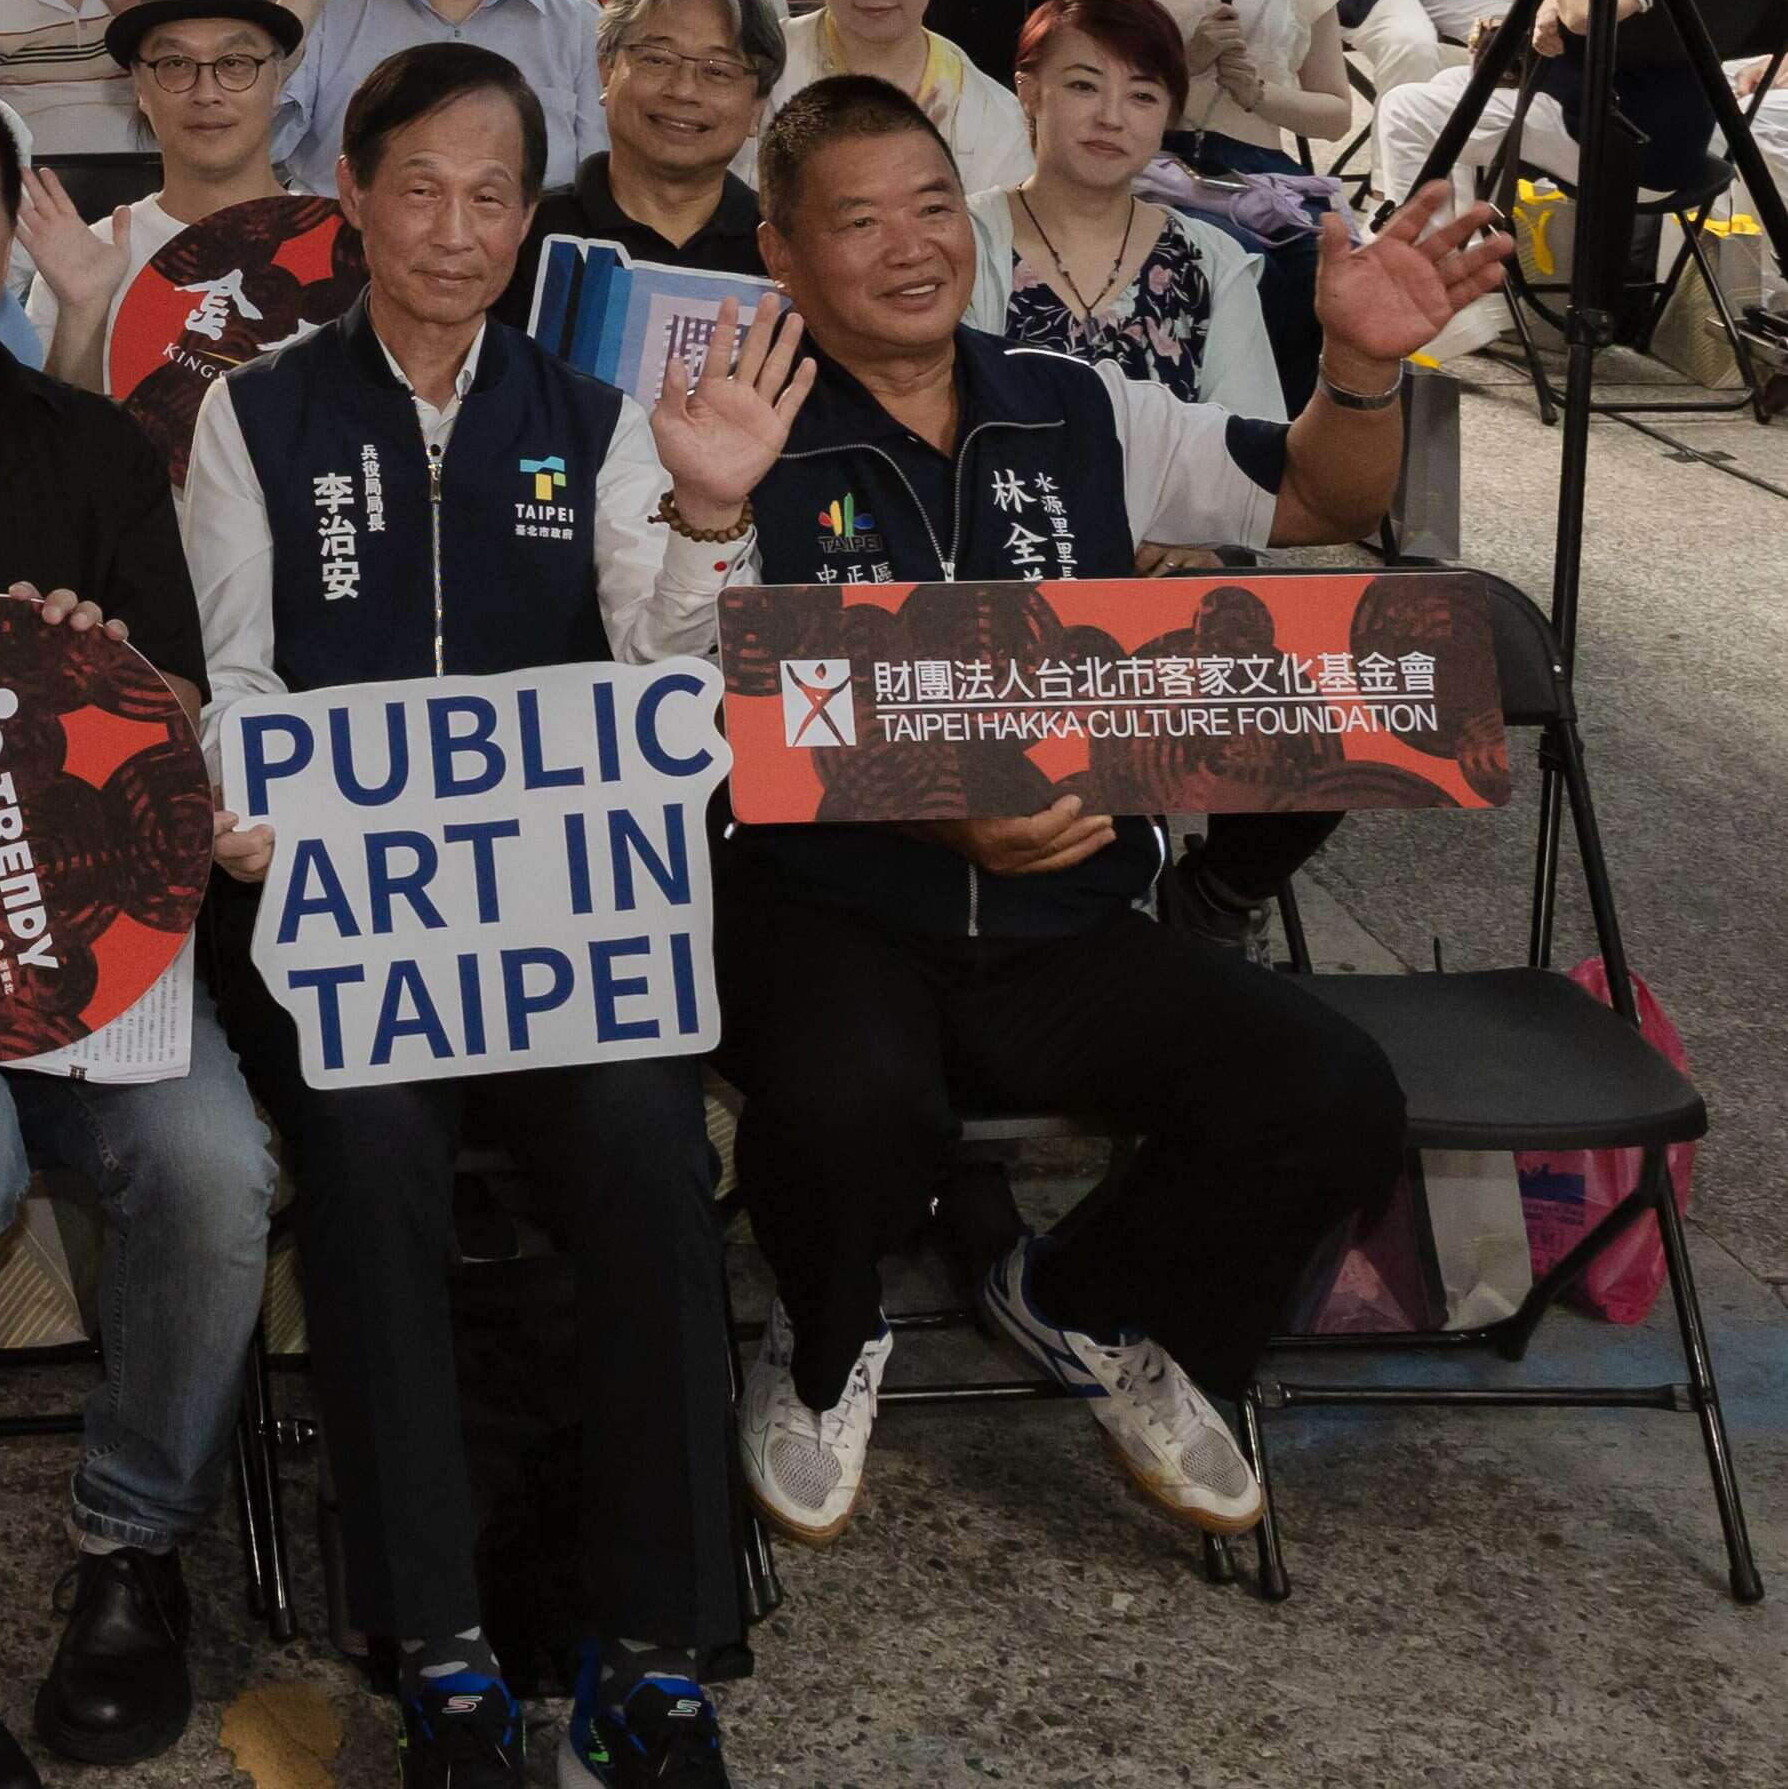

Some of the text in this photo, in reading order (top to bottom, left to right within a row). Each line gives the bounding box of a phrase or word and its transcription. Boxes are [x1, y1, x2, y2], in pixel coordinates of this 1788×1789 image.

[361, 444, 387, 532] 兵役局局長
[514, 503, 575, 523] TAIPEI
[313, 472, 361, 602] 李治安
[815, 561, 895, 585] 中正區
[873, 650, 1437, 704] 財團法人台北市客家文化基金會
[239, 672, 715, 818] PUBLIC
[877, 703, 1439, 743] TAIPEI HAKKA CULTURE FOUNDATION
[275, 803, 695, 946] ART IN
[288, 931, 701, 1072] TAIPEI
